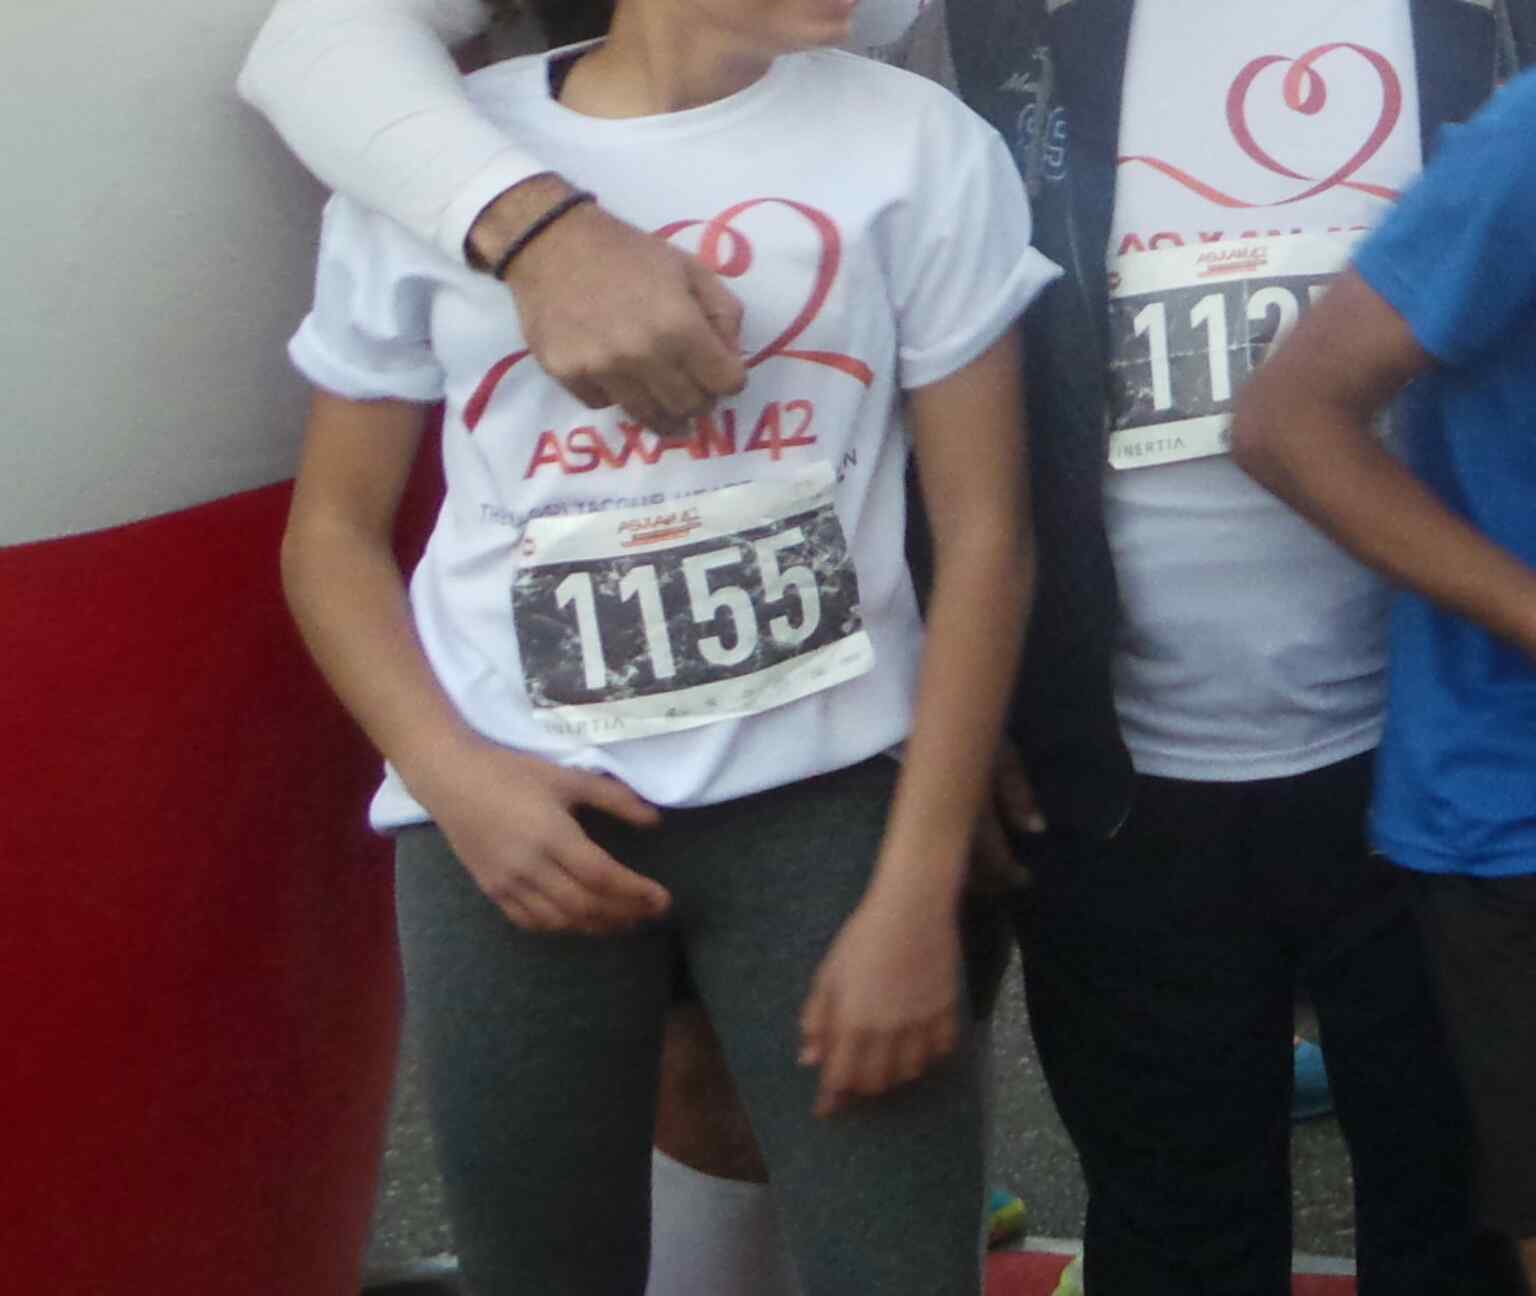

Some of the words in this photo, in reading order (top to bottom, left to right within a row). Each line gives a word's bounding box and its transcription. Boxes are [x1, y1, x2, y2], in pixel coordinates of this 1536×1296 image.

[1133, 285, 1328, 412] 112
[744, 399, 817, 461] 42
[555, 526, 822, 691] 1155
